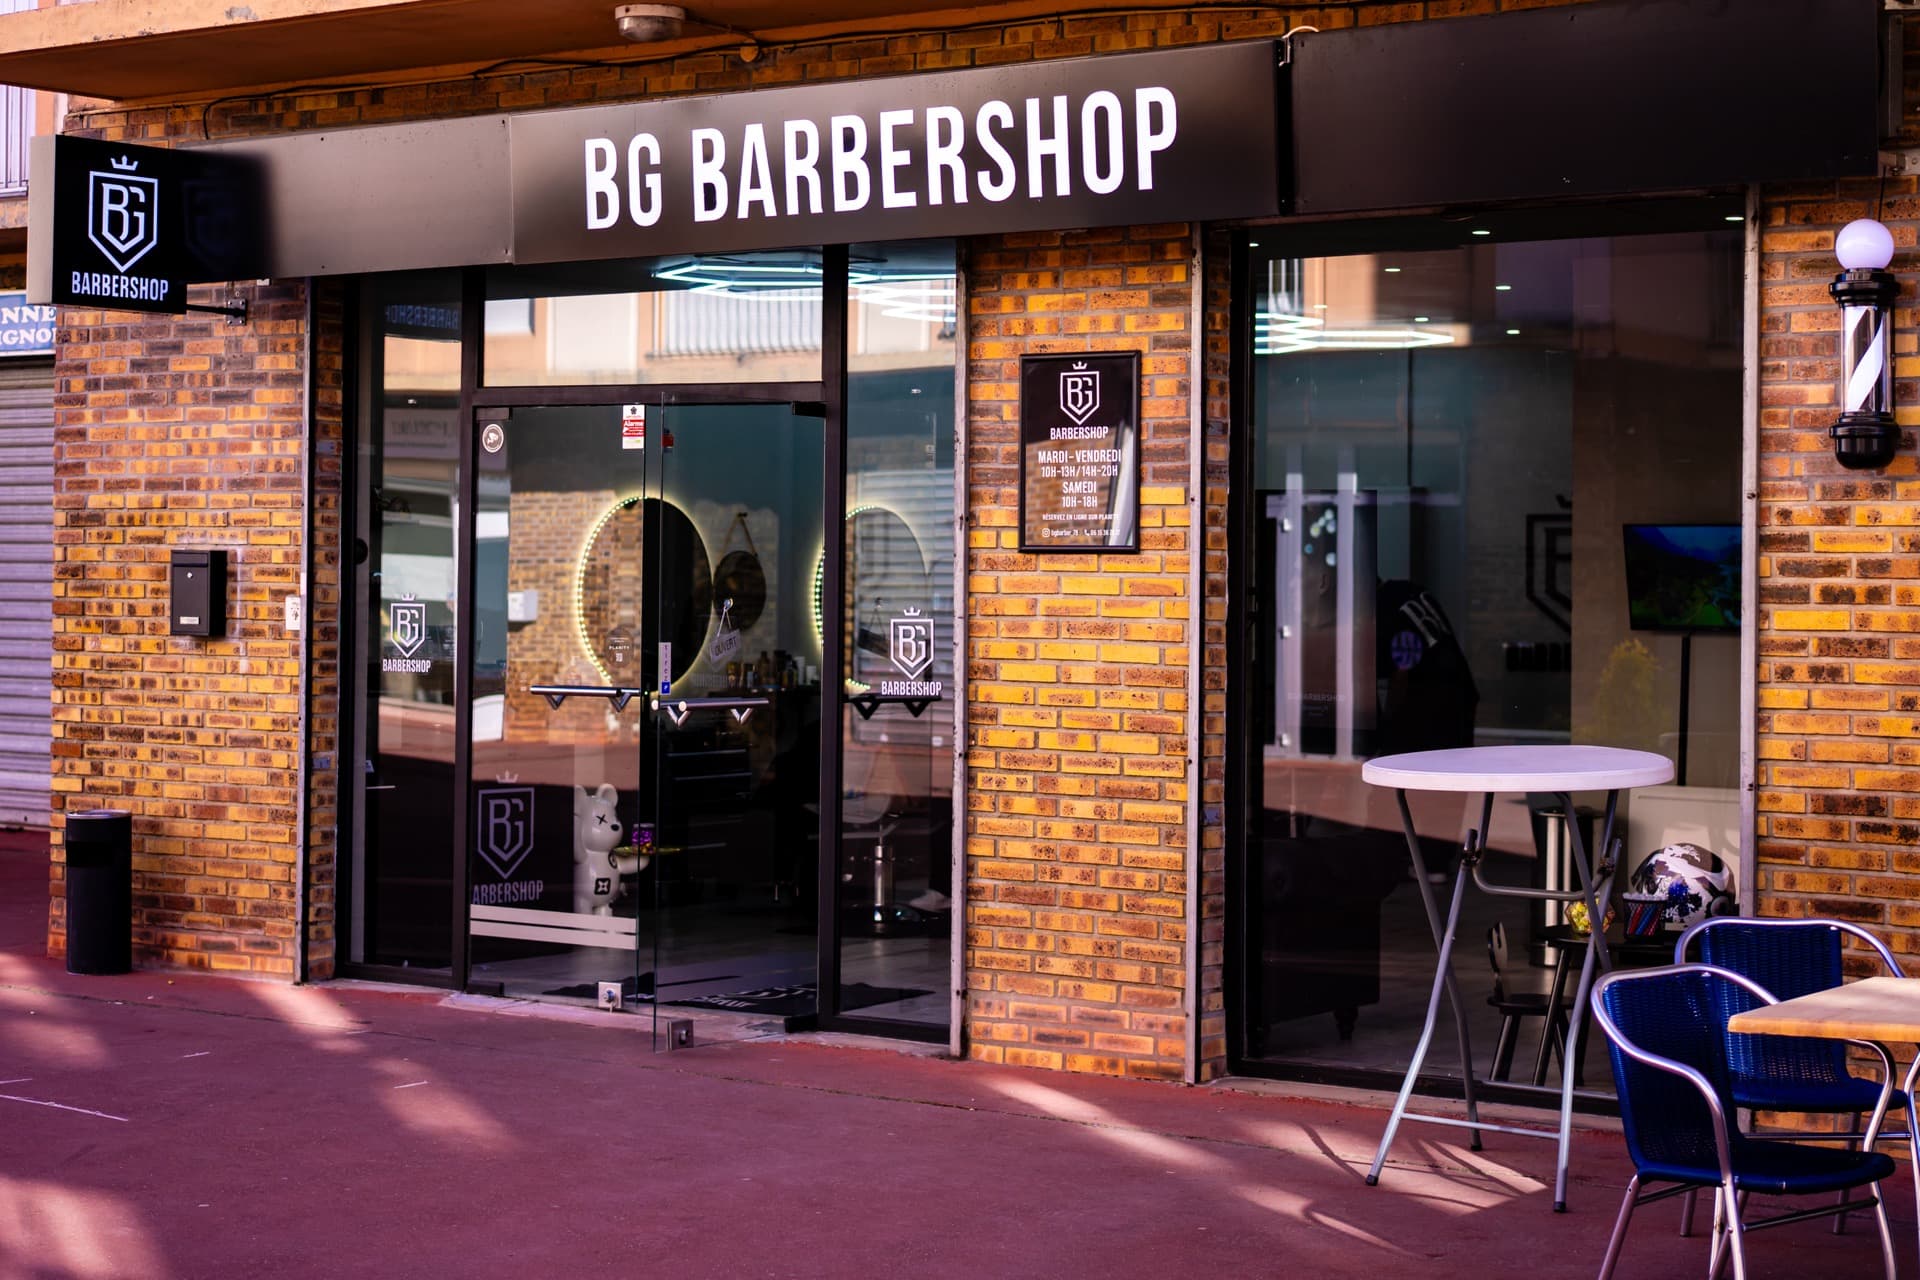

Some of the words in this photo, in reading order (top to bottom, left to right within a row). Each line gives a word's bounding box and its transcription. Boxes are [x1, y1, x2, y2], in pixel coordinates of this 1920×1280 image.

[584, 132, 663, 230] BG
[691, 86, 1178, 223] BARBERSHOP
[101, 182, 146, 253] BG
[71, 271, 169, 301] BARBERSHOP
[1066, 377, 1093, 416] BG
[1050, 426, 1109, 440] BARBERSHOP
[1062, 481, 1097, 494] SAMEDI
[397, 609, 420, 648] BG
[714, 636, 737, 656] OUVERT
[898, 625, 926, 668] BG
[382, 658, 432, 673] BARBERSHOP
[881, 681, 943, 696] BARBERSHOP
[488, 798, 525, 861] BG
[472, 880, 544, 905] ARBERSHOP
